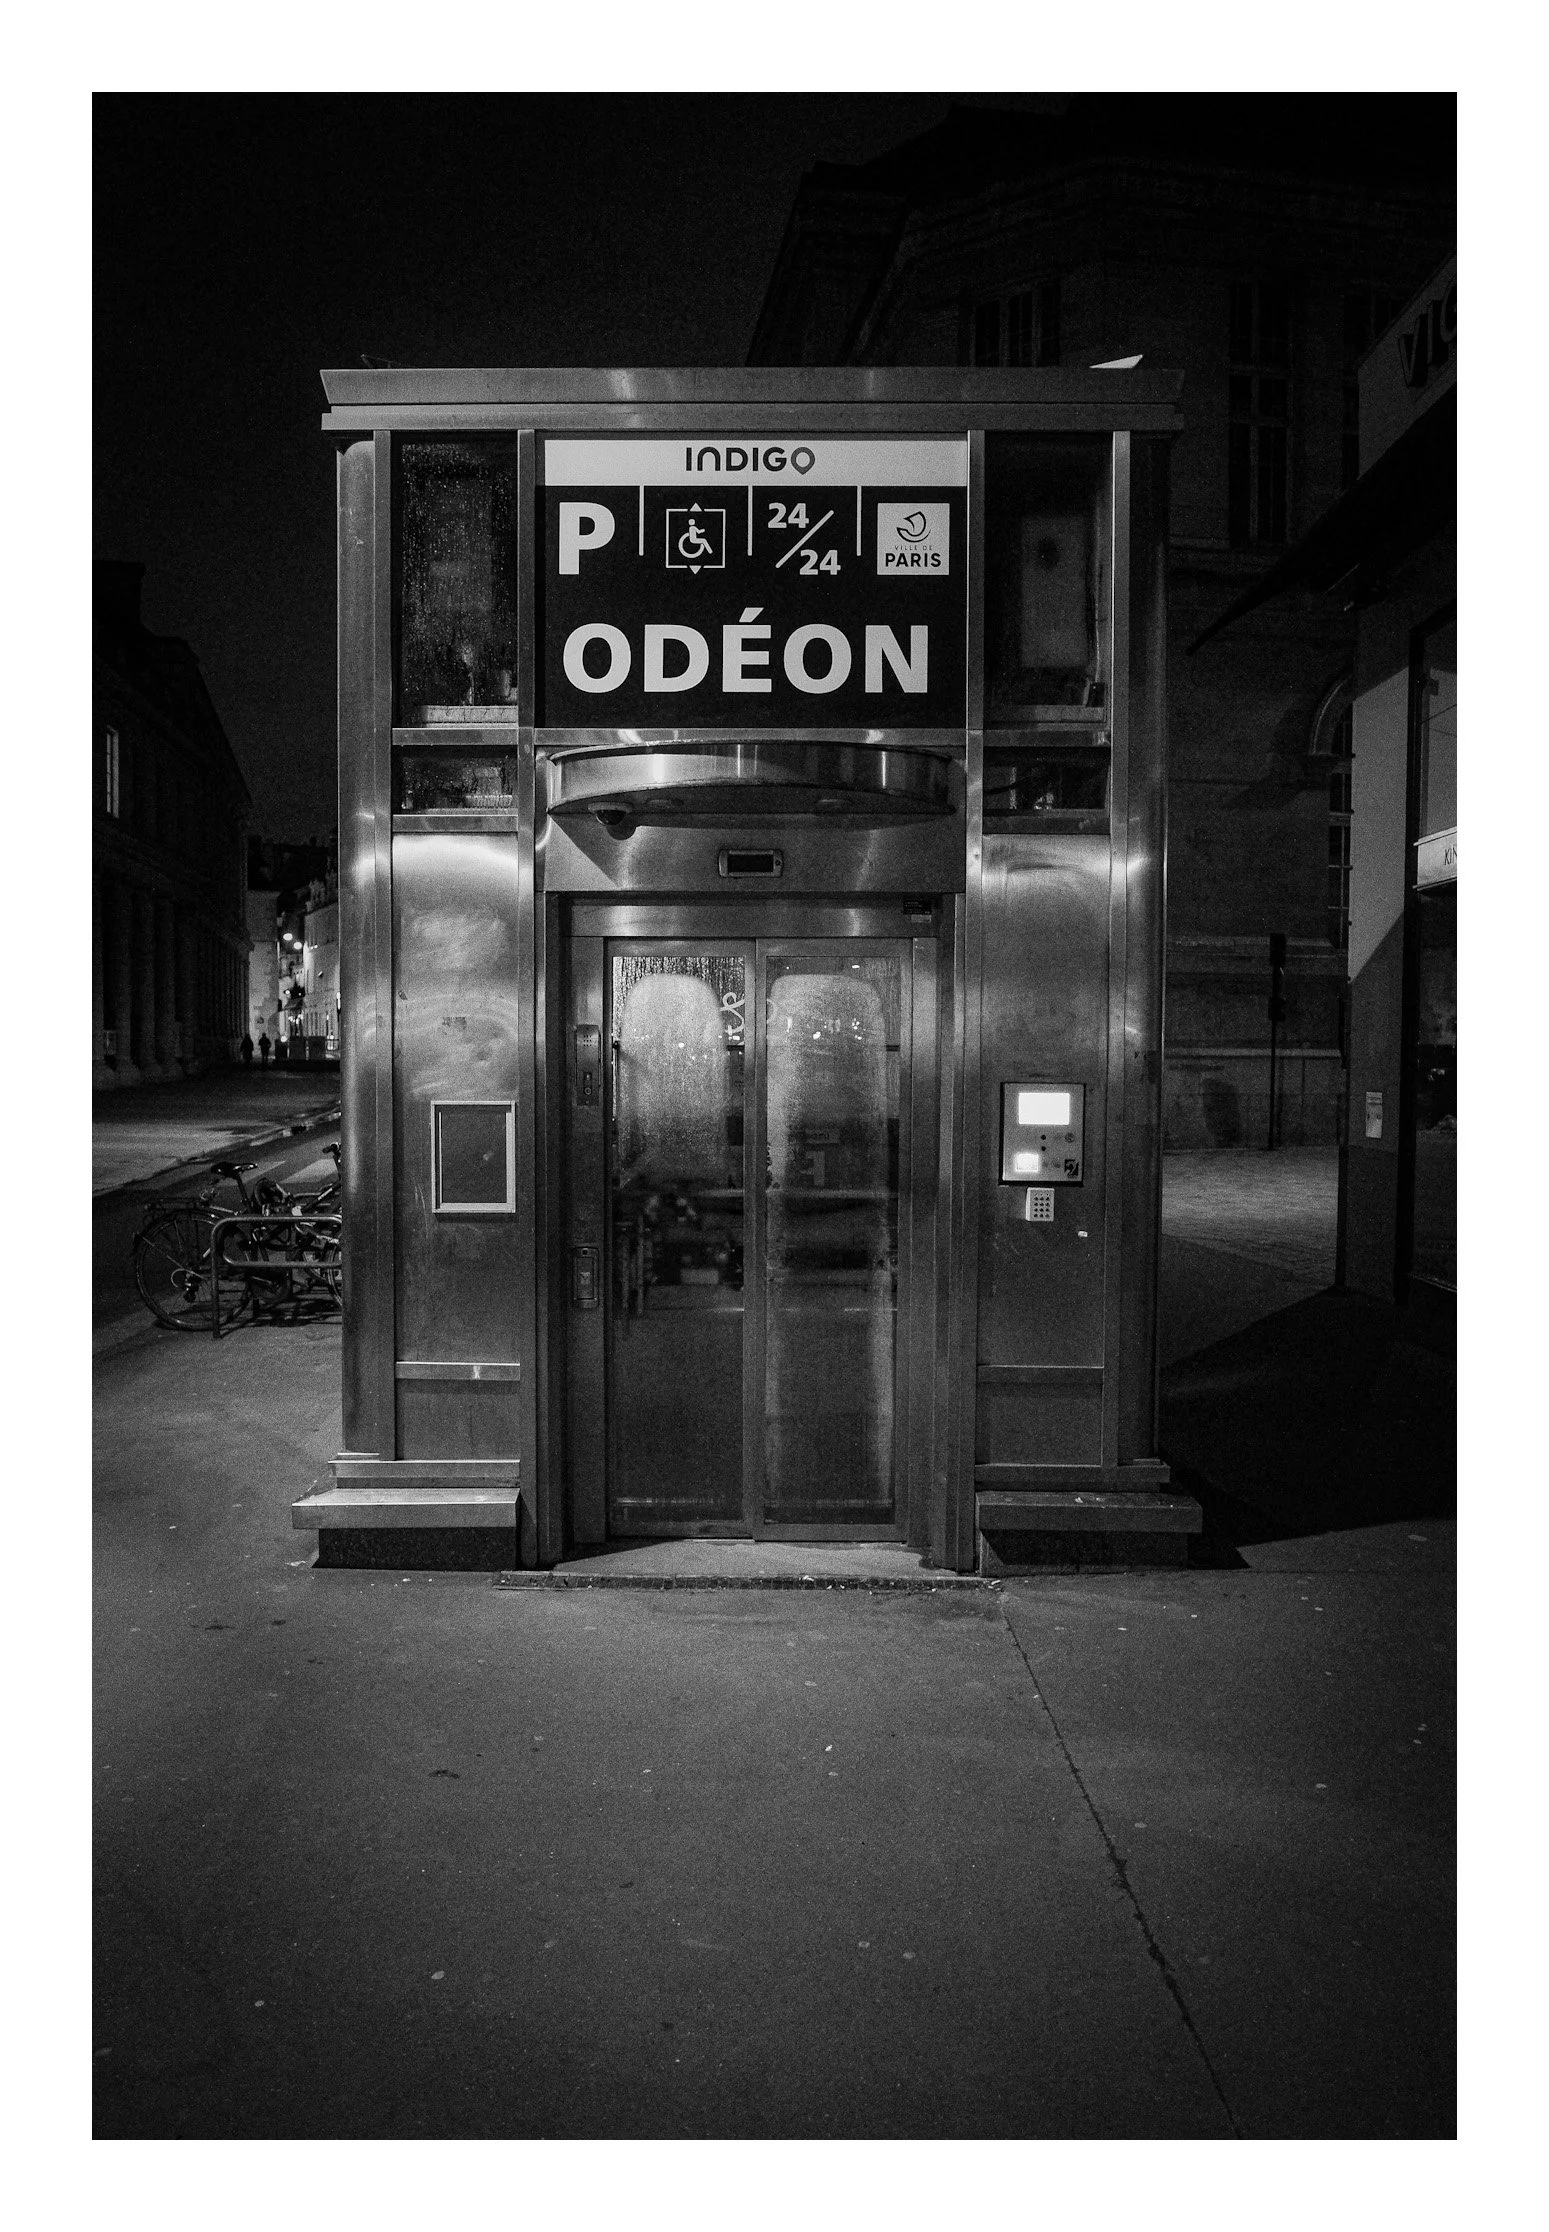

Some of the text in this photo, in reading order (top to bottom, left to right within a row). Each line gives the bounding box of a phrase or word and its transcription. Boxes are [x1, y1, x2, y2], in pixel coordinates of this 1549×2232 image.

[686, 446, 815, 475] INDIGO
[559, 502, 615, 575] P
[885, 553, 941, 567] PARIS
[563, 608, 928, 693] ODÉON
